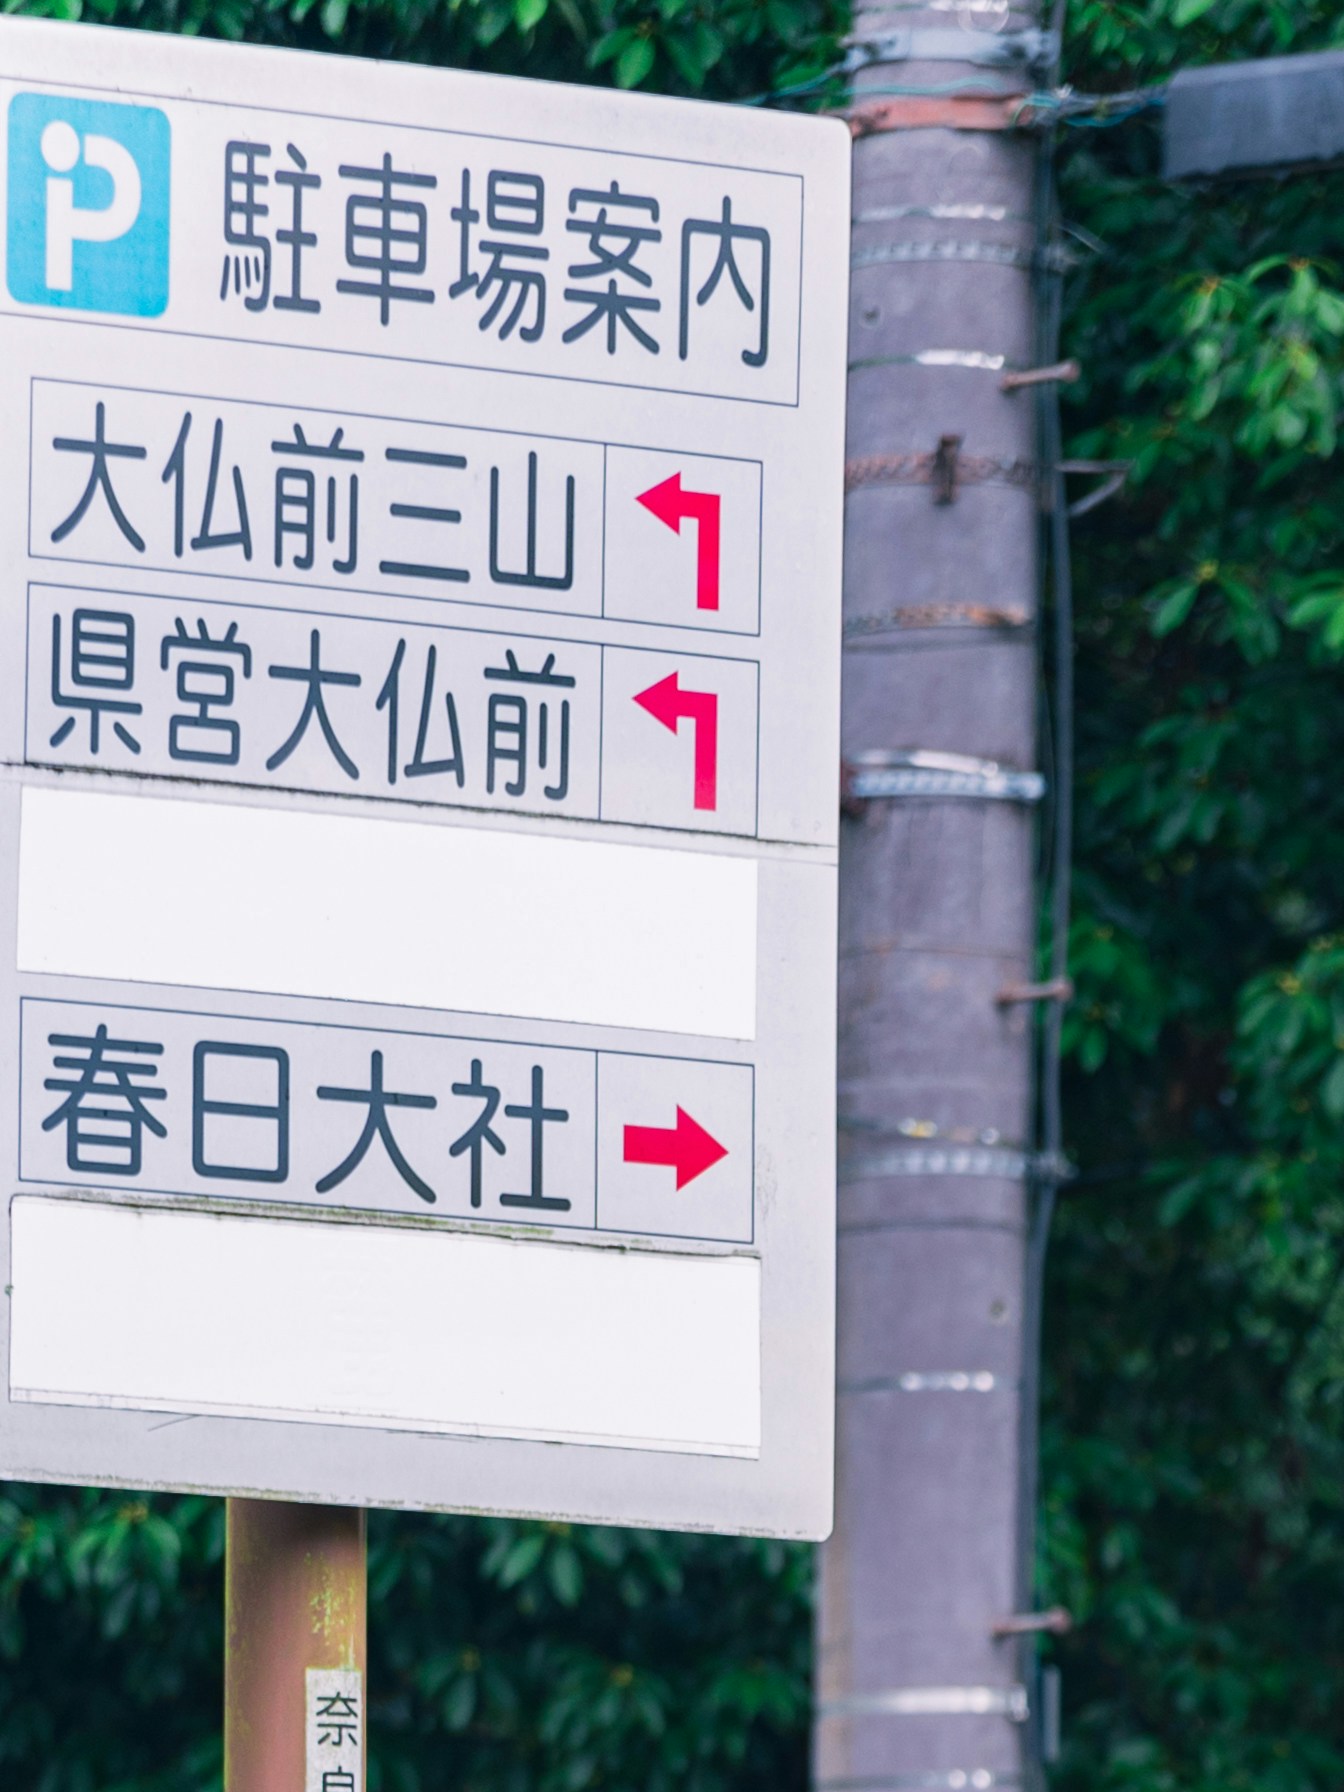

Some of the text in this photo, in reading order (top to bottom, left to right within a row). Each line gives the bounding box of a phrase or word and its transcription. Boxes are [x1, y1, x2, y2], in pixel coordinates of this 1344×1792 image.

[219, 138, 772, 369] 駐車場案内
[51, 401, 576, 591] 大仏前三山
[49, 607, 576, 801] 県営大仏前
[41, 1023, 572, 1212] 春日大社
